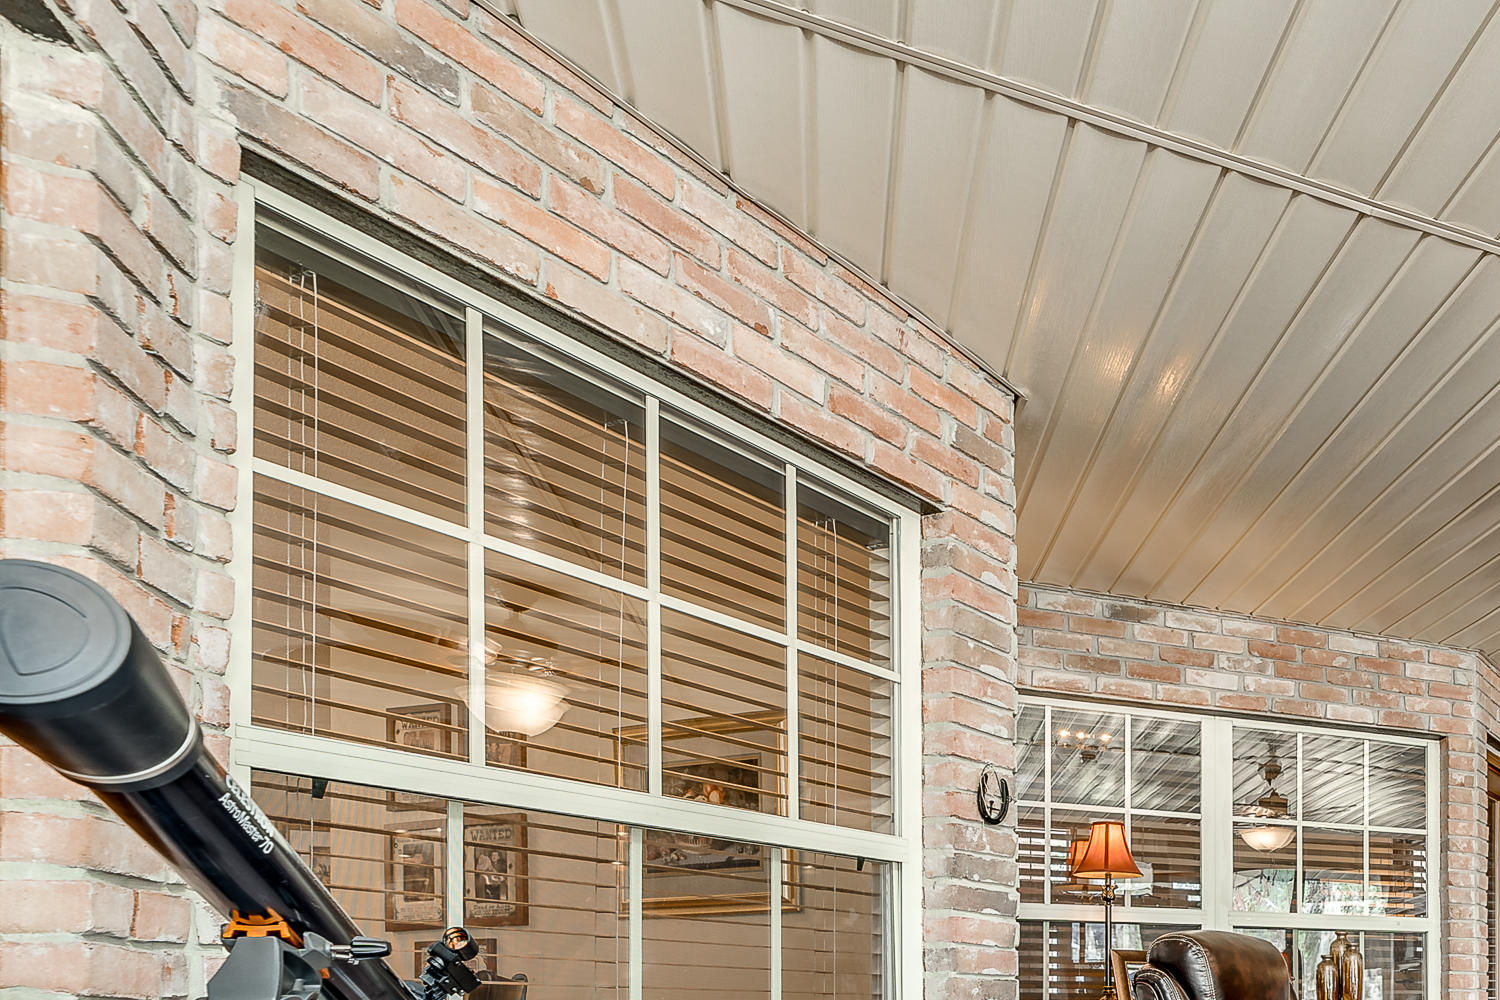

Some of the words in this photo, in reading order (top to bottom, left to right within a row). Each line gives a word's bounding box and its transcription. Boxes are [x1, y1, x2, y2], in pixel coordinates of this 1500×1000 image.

[218, 792, 264, 842] AstroMaster
[258, 836, 275, 854] 70
[469, 827, 513, 842] WANTED
